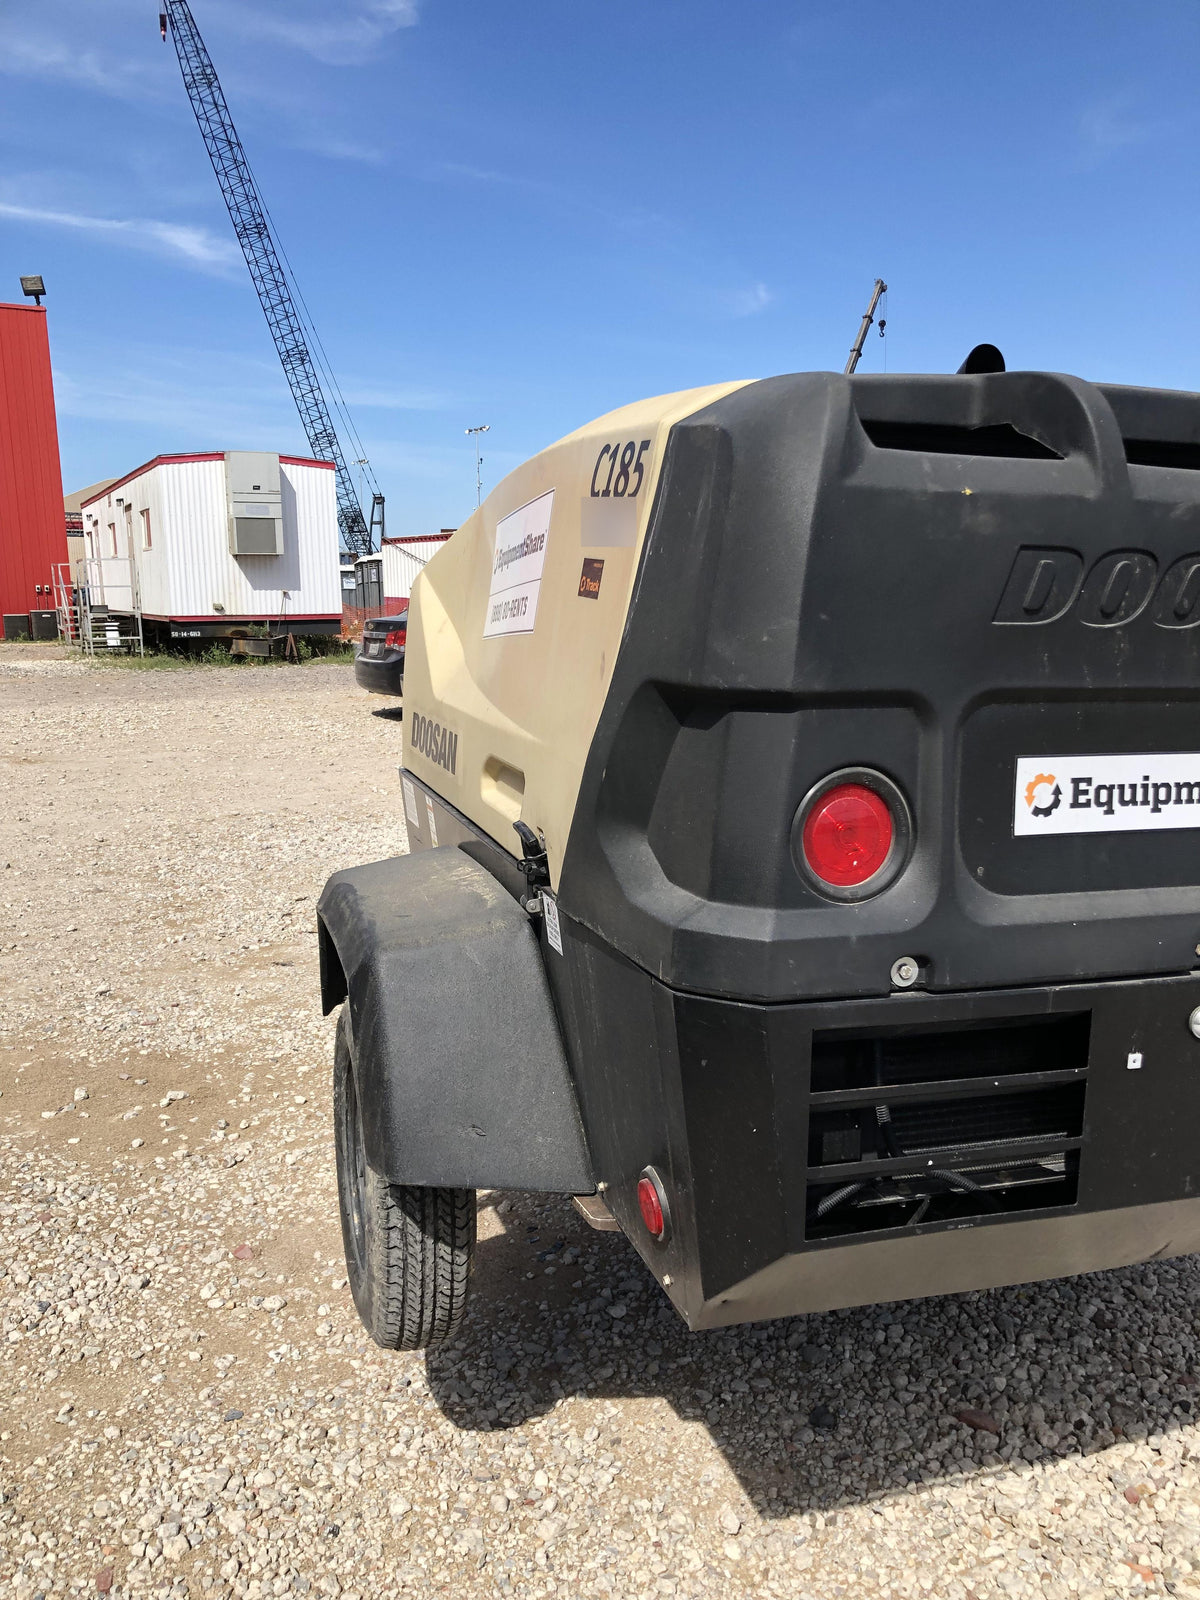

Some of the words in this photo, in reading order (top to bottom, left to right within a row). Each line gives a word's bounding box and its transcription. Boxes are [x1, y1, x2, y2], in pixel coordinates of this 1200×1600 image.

[591, 440, 651, 498] C185
[586, 578, 600, 592] Track
[411, 712, 458, 775] DOOSAN
